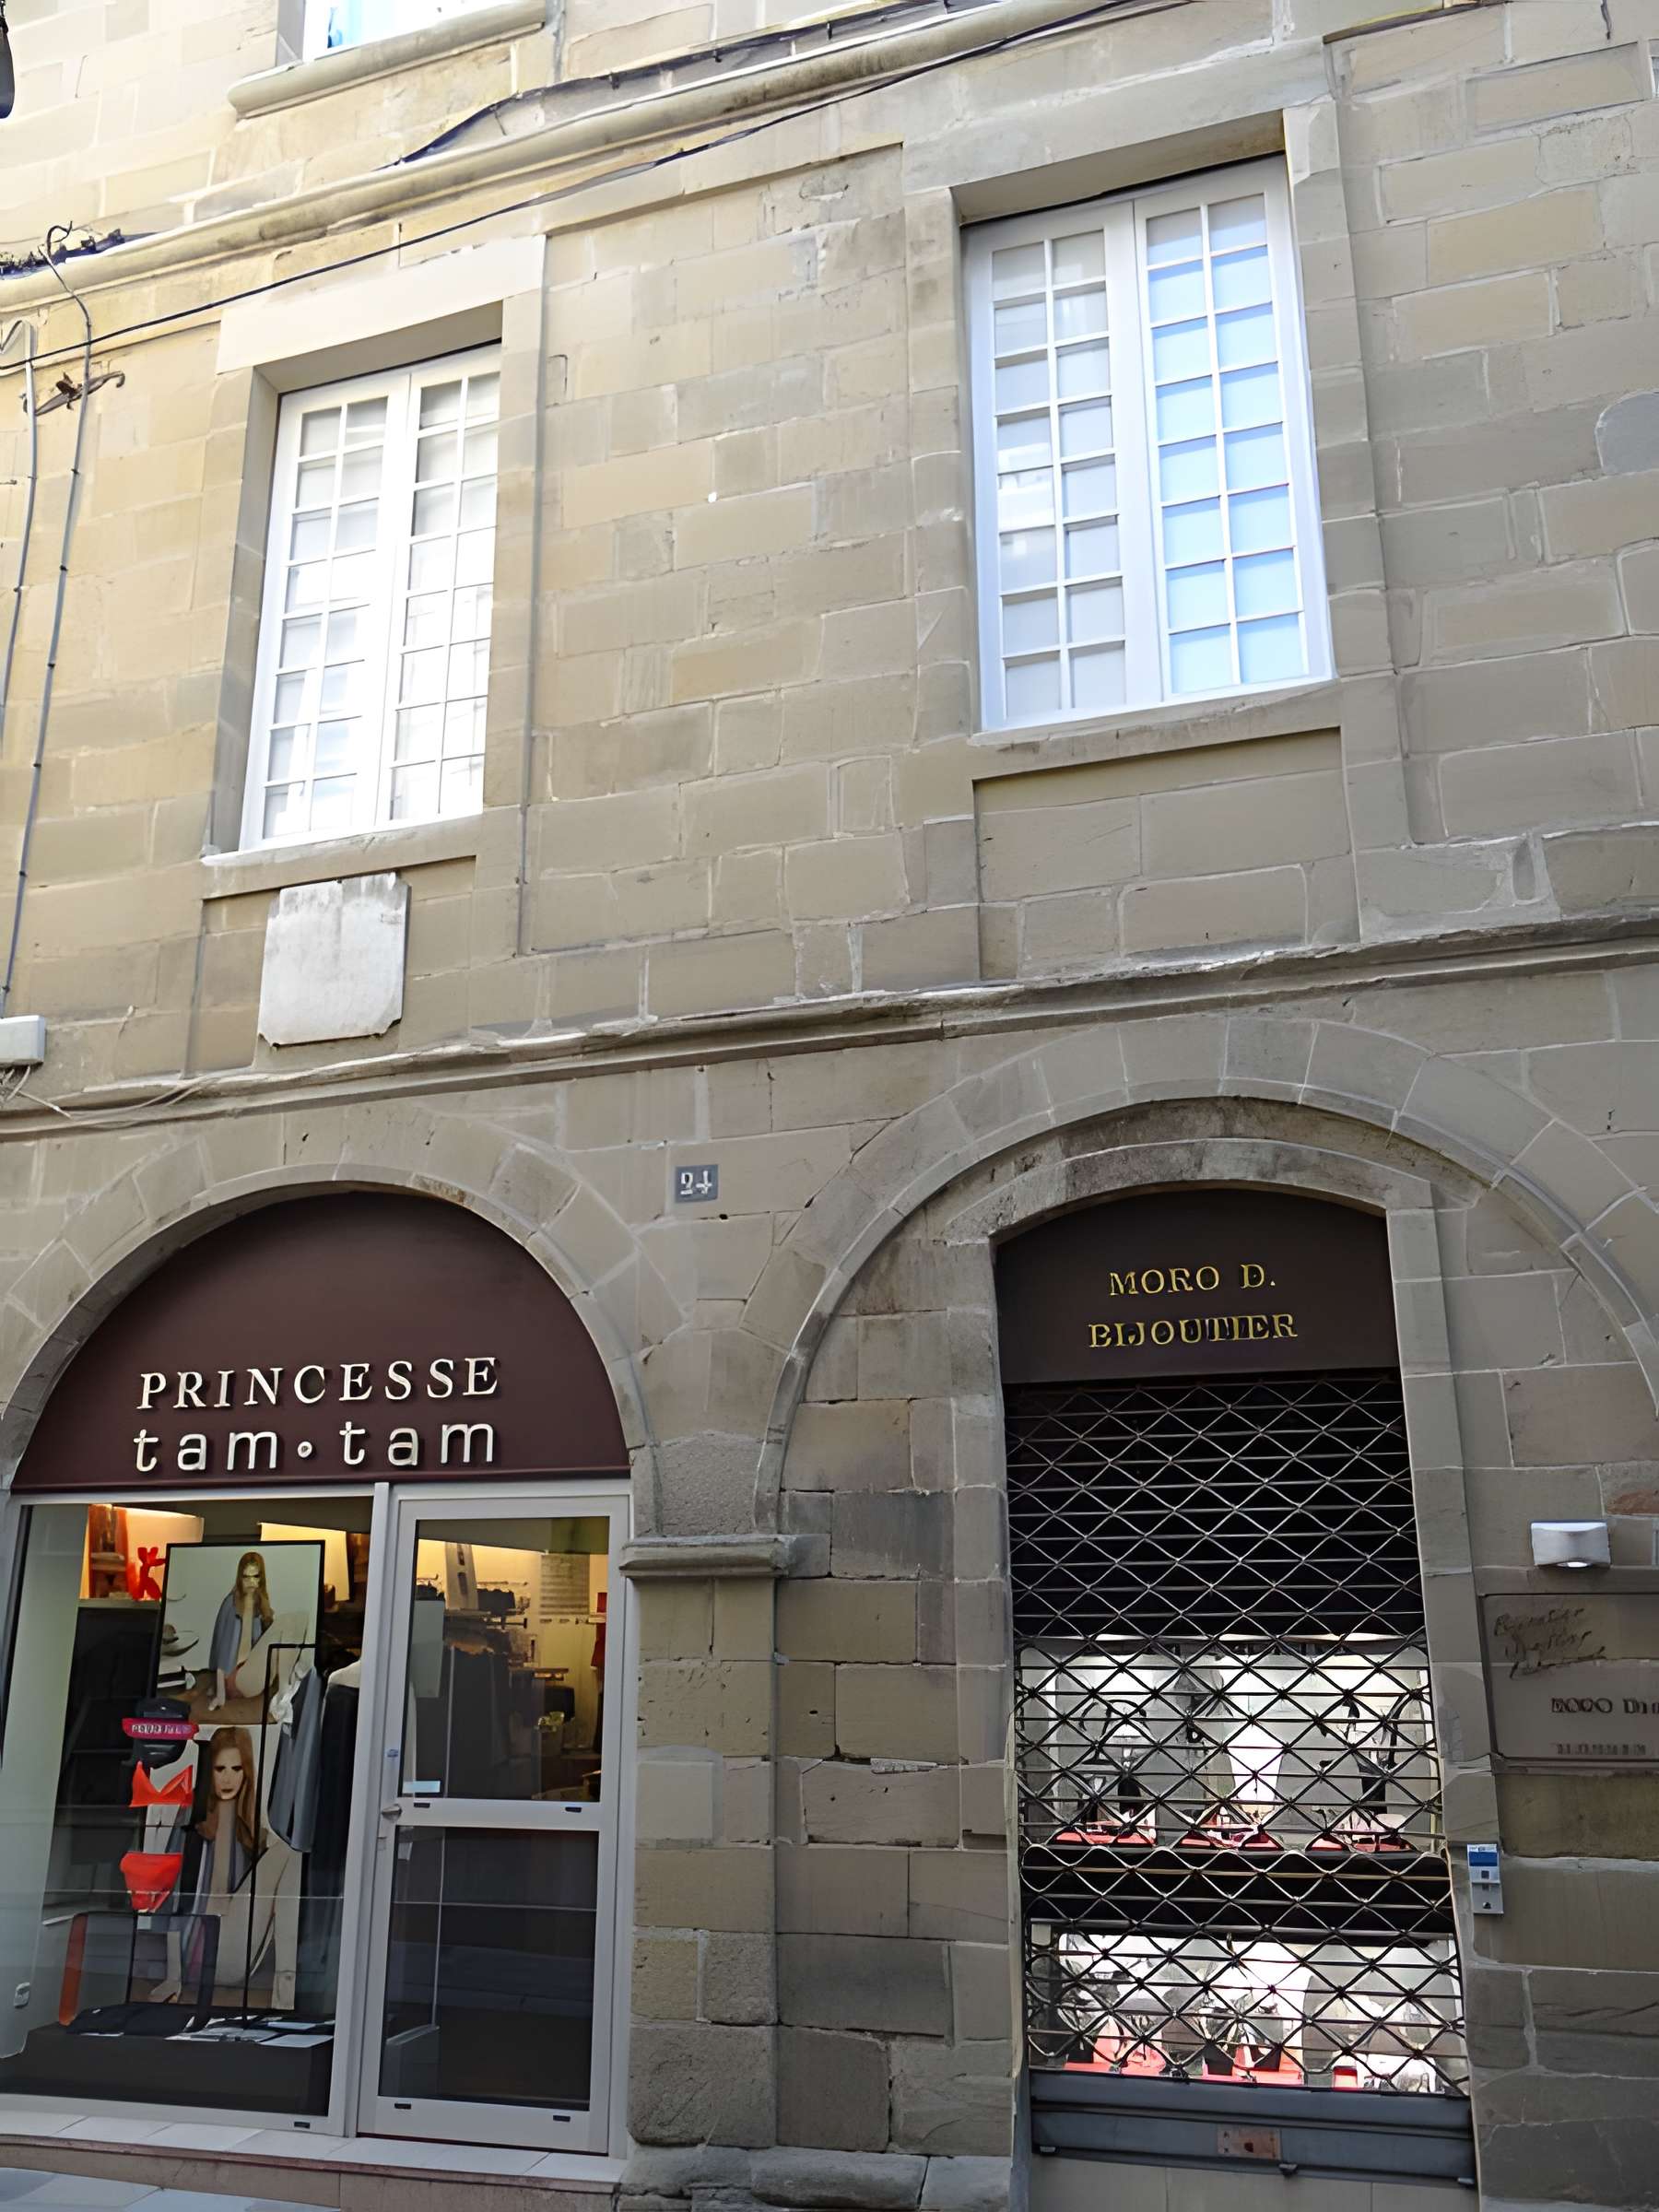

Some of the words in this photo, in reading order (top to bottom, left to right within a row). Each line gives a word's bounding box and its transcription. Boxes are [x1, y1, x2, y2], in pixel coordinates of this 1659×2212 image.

[680, 1170, 712, 1195] 24
[1110, 1265, 1219, 1296] MORO
[1241, 1264, 1276, 1289] D.
[1088, 1313, 1298, 1347] BIJOUTIER
[136, 1357, 499, 1410] PRINCESSE
